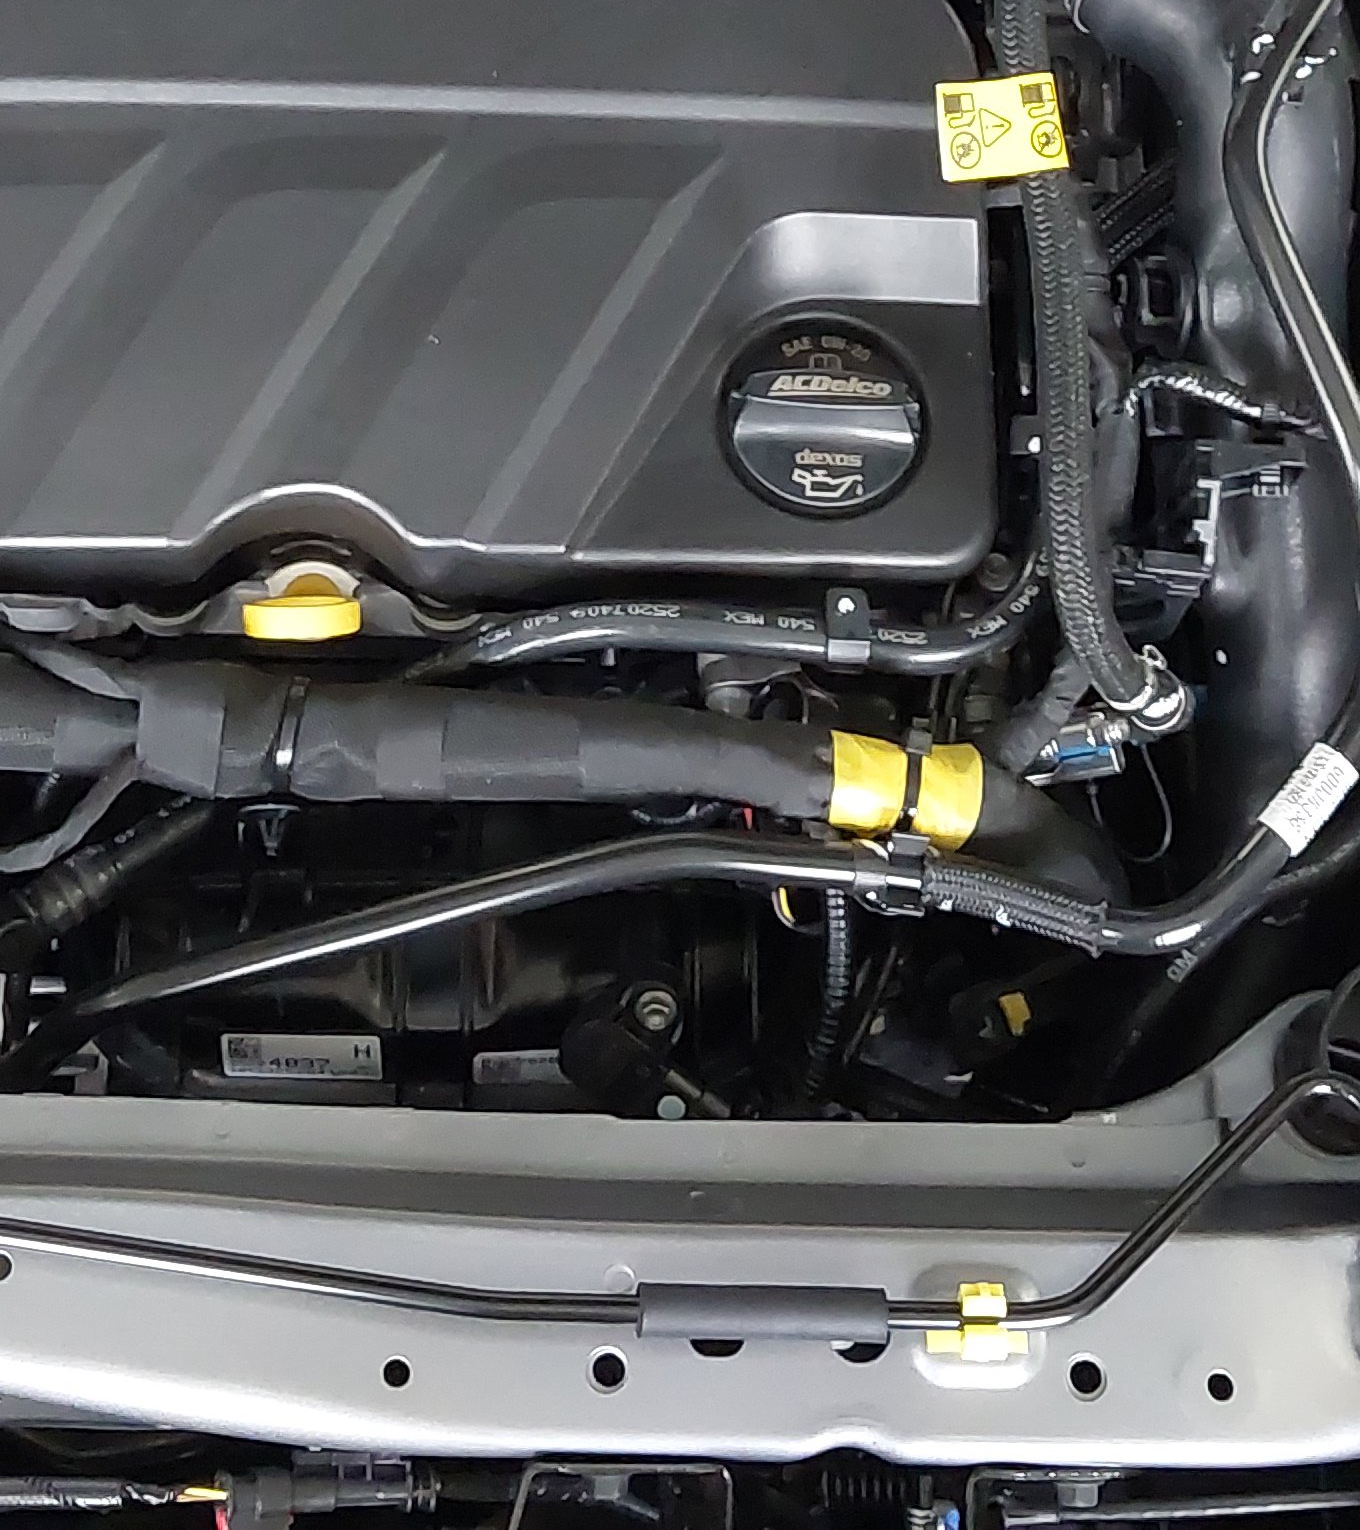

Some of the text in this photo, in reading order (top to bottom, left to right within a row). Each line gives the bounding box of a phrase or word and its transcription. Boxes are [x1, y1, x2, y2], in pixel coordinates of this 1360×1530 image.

[769, 373, 893, 396] ACDelco
[794, 447, 863, 468] dexos
[723, 610, 765, 626] MEX
[876, 627, 929, 645] 2520
